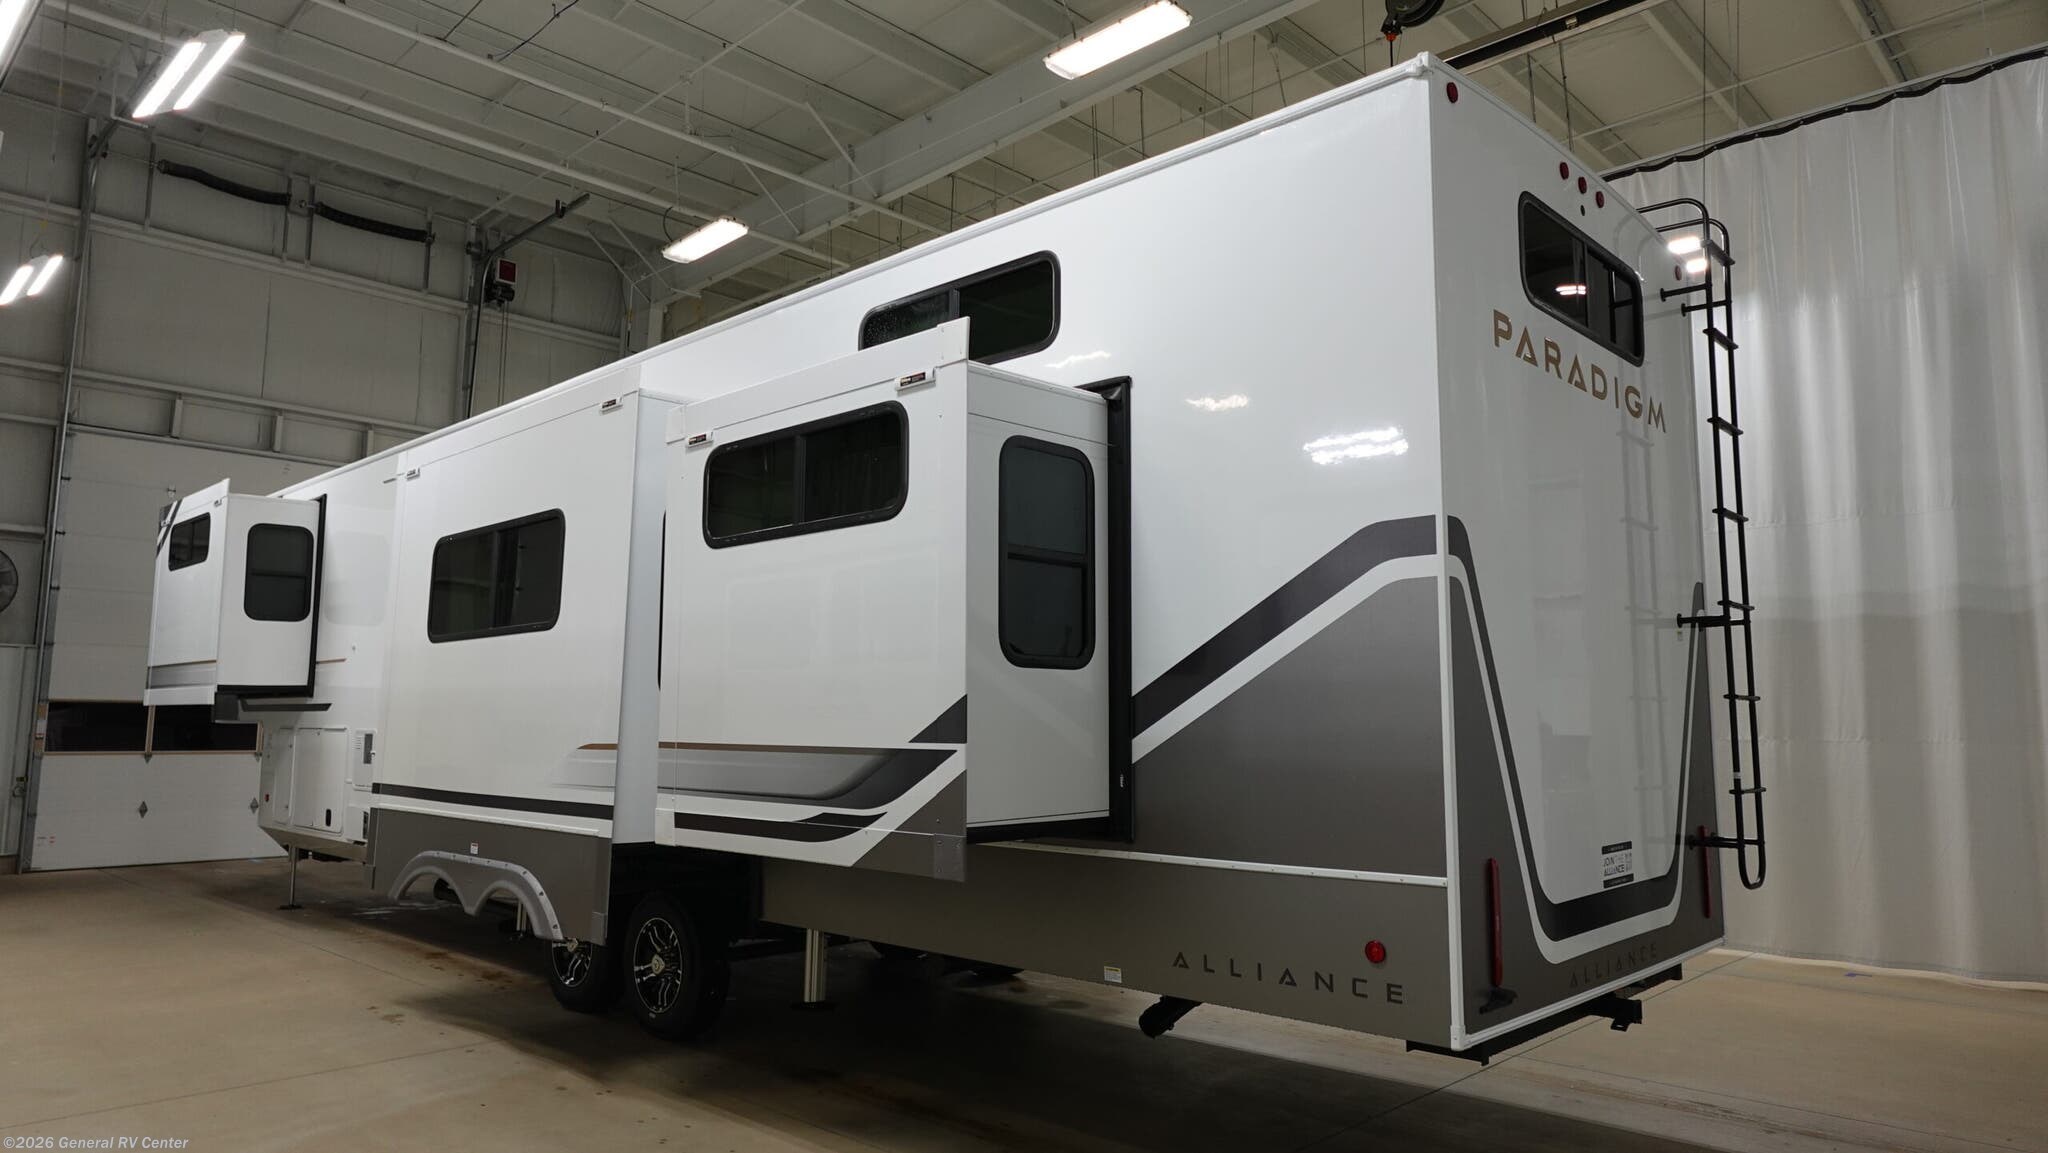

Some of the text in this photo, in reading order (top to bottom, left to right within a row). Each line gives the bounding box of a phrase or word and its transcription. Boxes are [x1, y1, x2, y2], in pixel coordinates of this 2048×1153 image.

[1493, 309, 1666, 433] PARADIGM
[1172, 951, 1403, 1004] ALLIANCE
[1569, 944, 1657, 989] ALLIANCE
